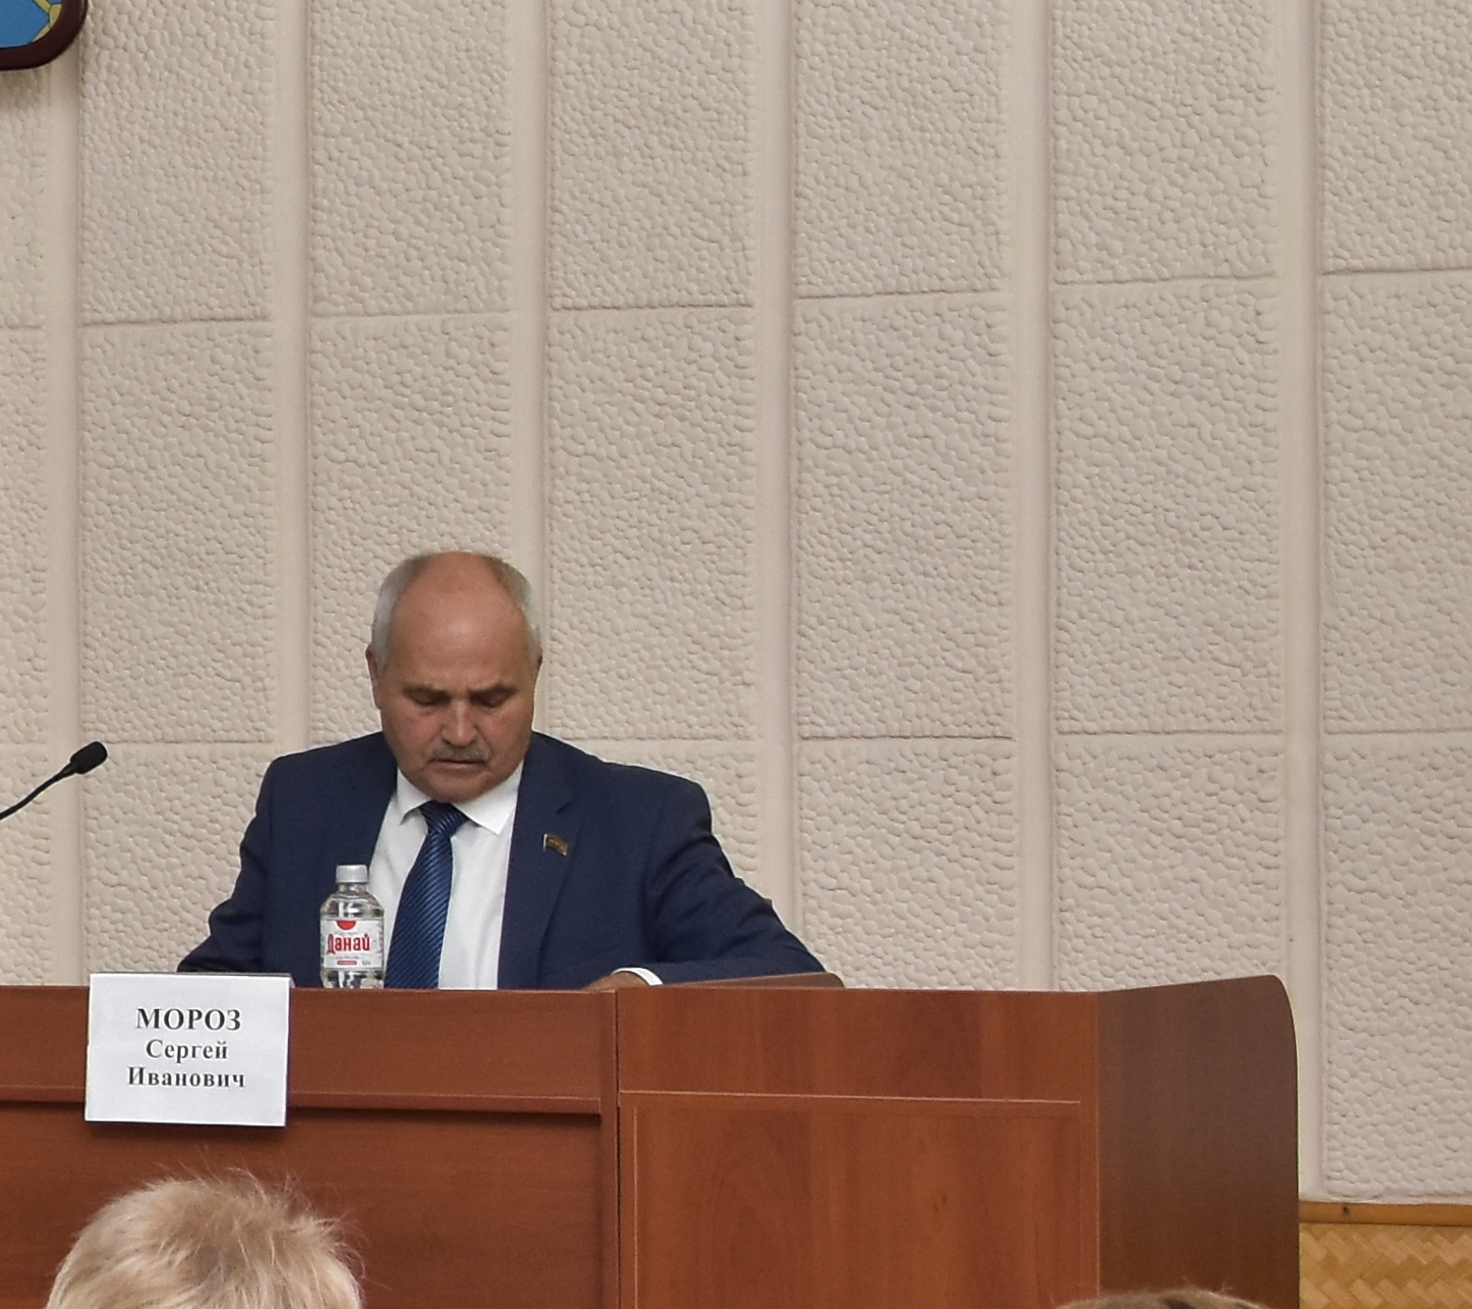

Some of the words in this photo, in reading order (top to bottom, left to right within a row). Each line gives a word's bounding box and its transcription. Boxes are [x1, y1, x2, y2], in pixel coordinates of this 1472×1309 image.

[327, 933, 371, 954] Данай
[135, 1008, 241, 1031] МОРОЗ
[145, 1039, 228, 1063] Сергей
[127, 1066, 245, 1088] Иванович
